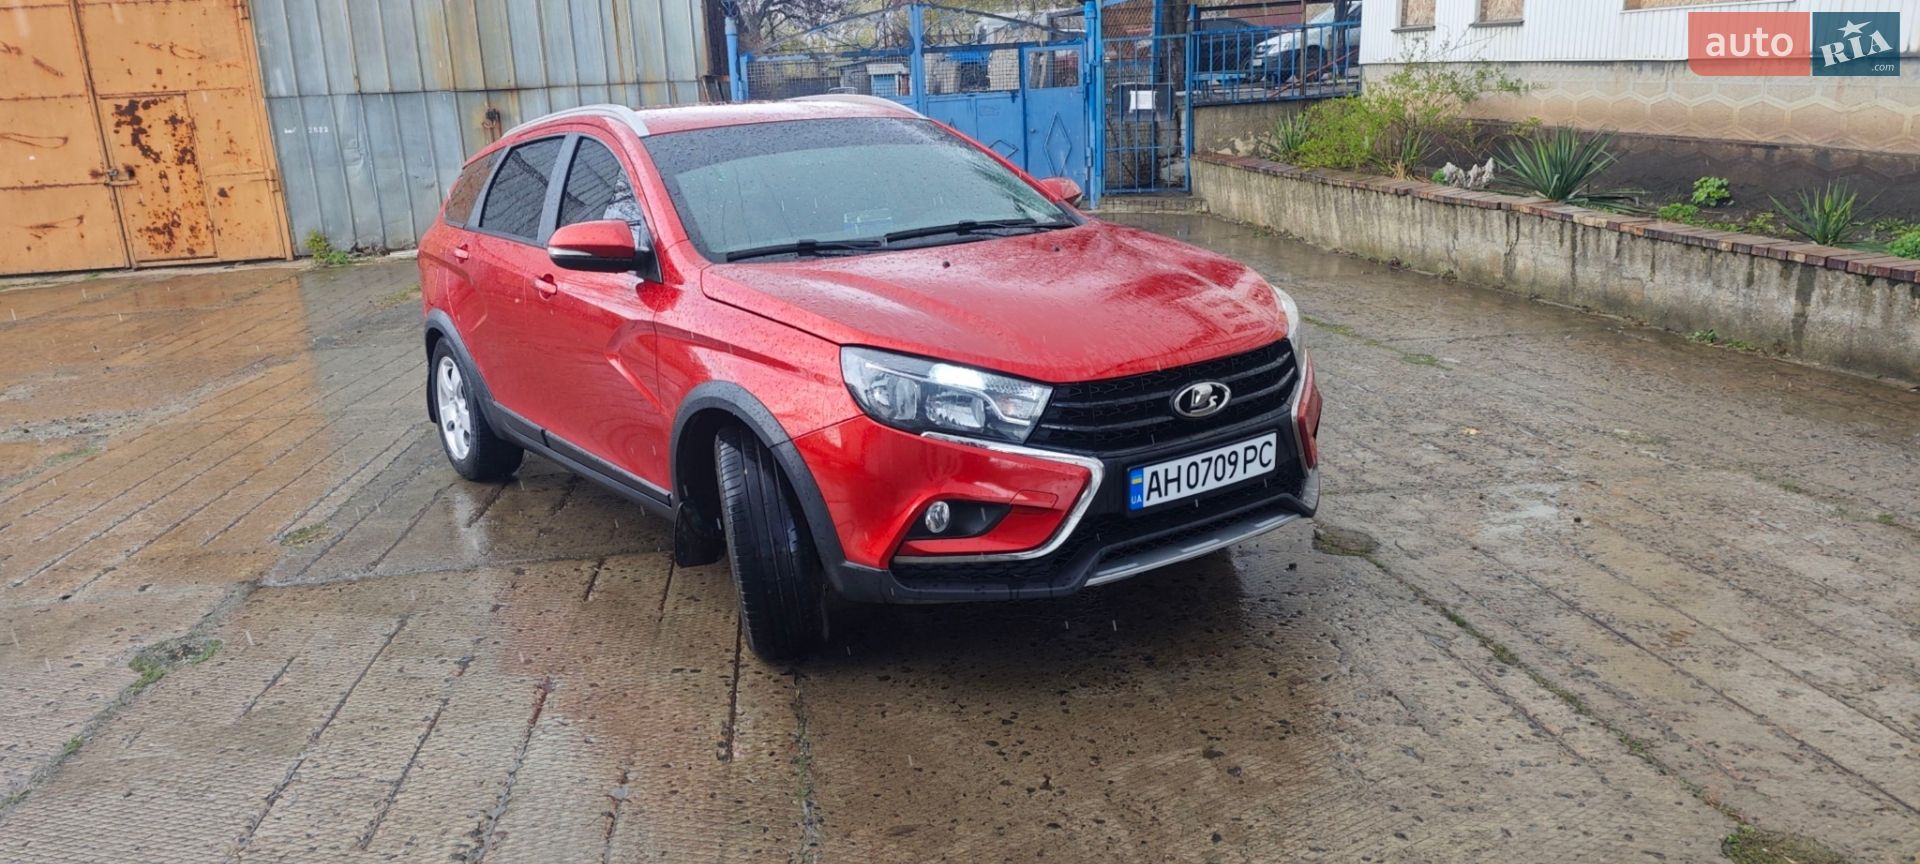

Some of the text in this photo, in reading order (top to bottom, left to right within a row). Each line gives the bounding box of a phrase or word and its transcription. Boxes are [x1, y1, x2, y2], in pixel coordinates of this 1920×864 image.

[1146, 441, 1273, 502] AH 0709 PC
[1131, 495, 1143, 504] UA
